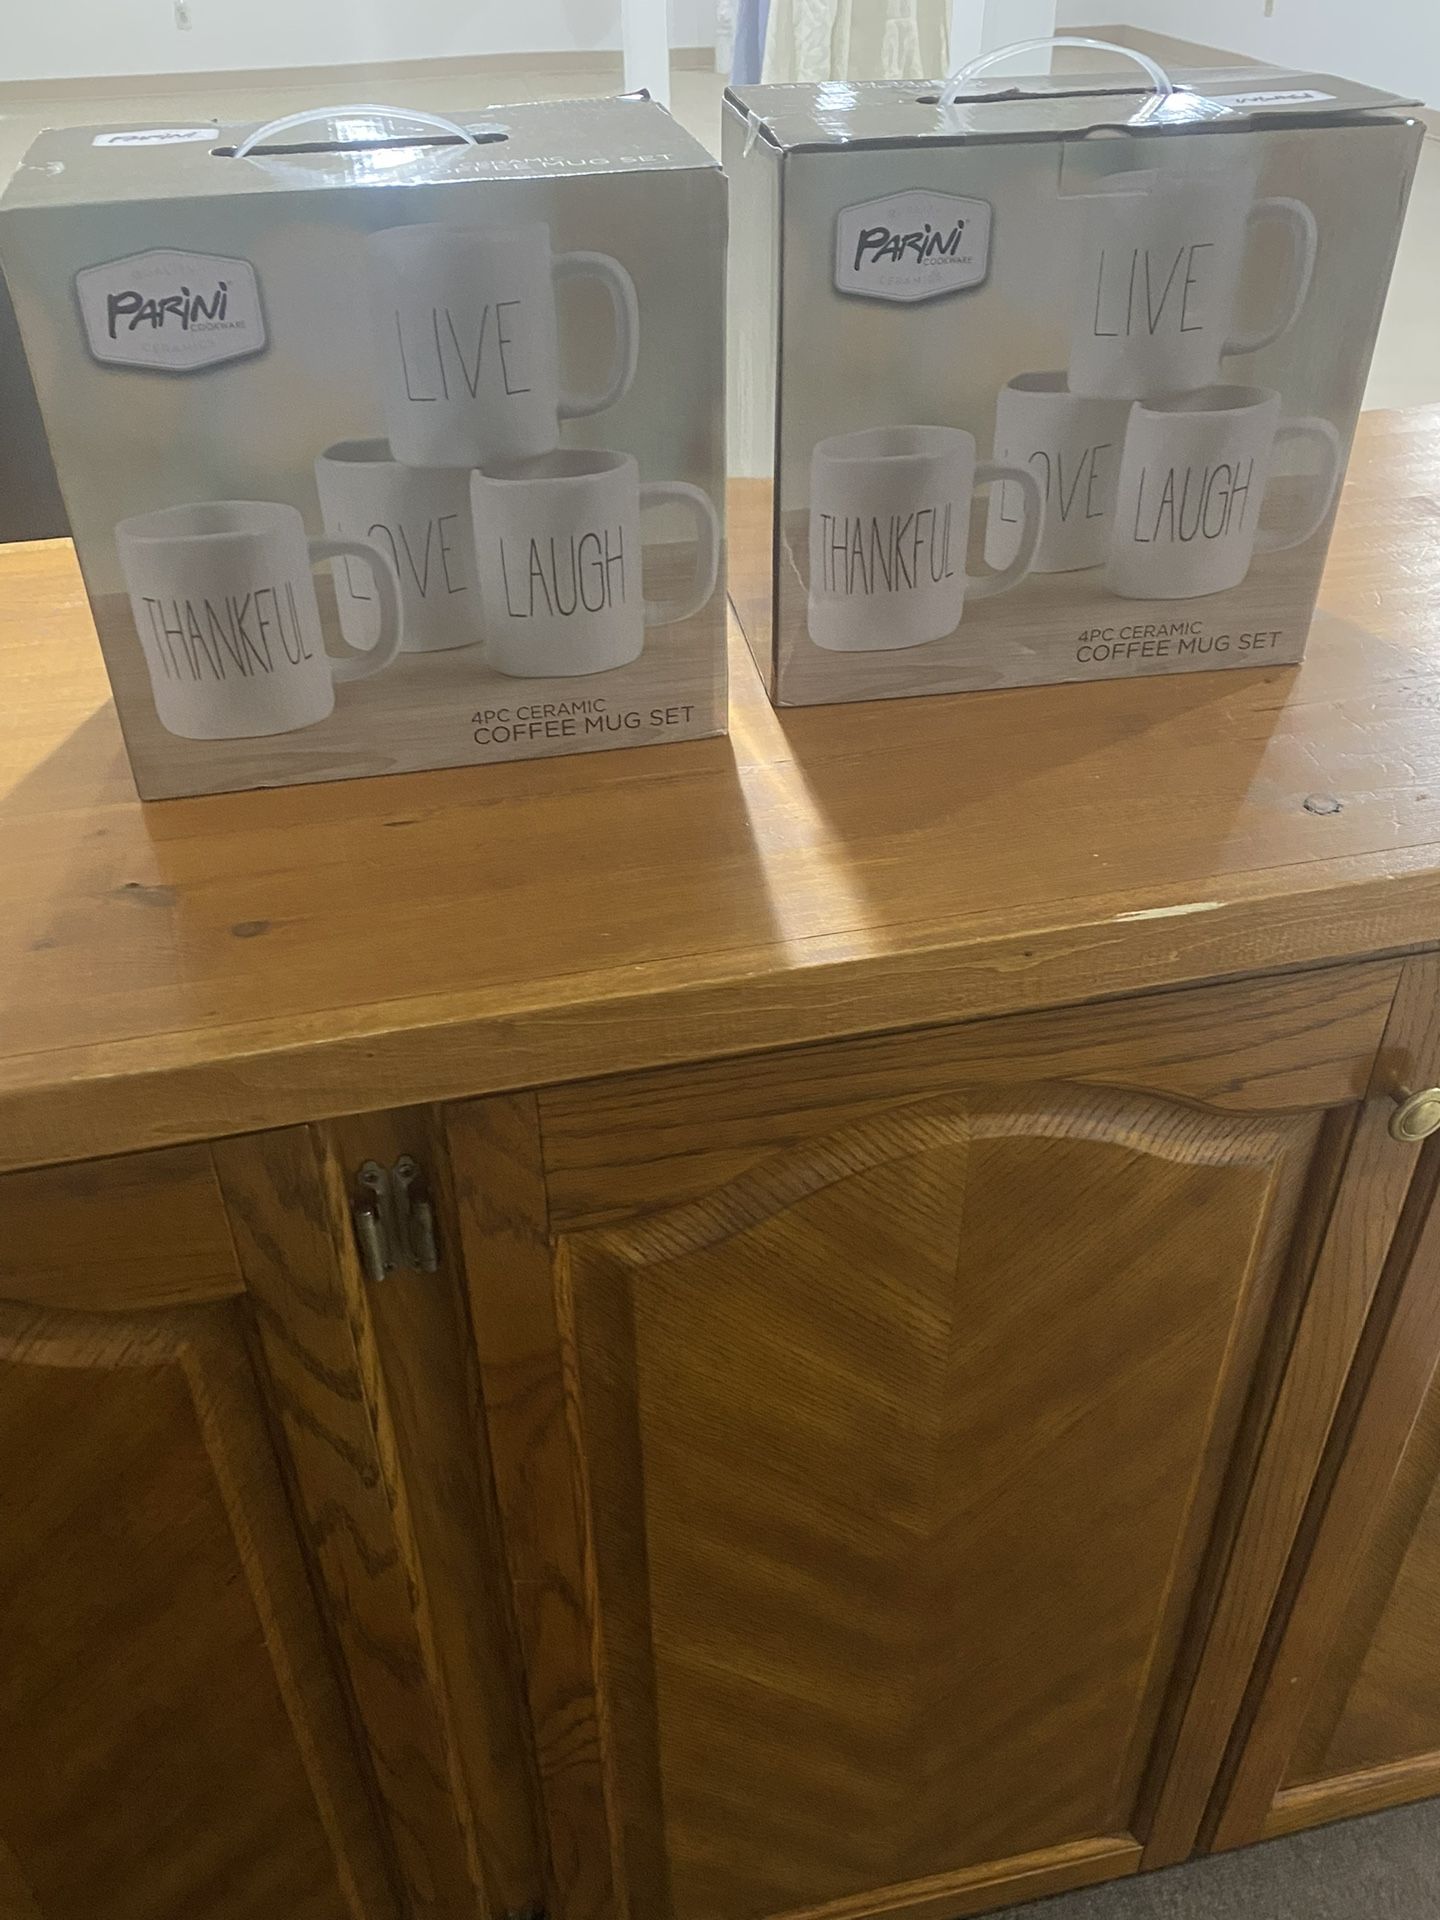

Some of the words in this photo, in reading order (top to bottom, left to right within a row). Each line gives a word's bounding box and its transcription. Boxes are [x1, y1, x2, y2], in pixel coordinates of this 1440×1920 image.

[1093, 243, 1214, 336] LIVE
[396, 301, 531, 401] LIVE
[1134, 458, 1254, 542] LAUGH
[500, 525, 625, 618] LAUGH
[820, 502, 954, 595] THANKFUL
[142, 581, 313, 680] THANKFUL
[1076, 639, 1171, 663] COFFEE
[1177, 635, 1230, 655] MUG
[1238, 631, 1283, 650] SET
[1078, 628, 1115, 642] 4PC
[1119, 621, 1203, 640] CERAMIC
[471, 708, 509, 725] 4PC
[516, 699, 607, 721] CERAMIC
[473, 719, 577, 745] COFFEE
[585, 712, 641, 734] MUG
[650, 706, 695, 727] SET
